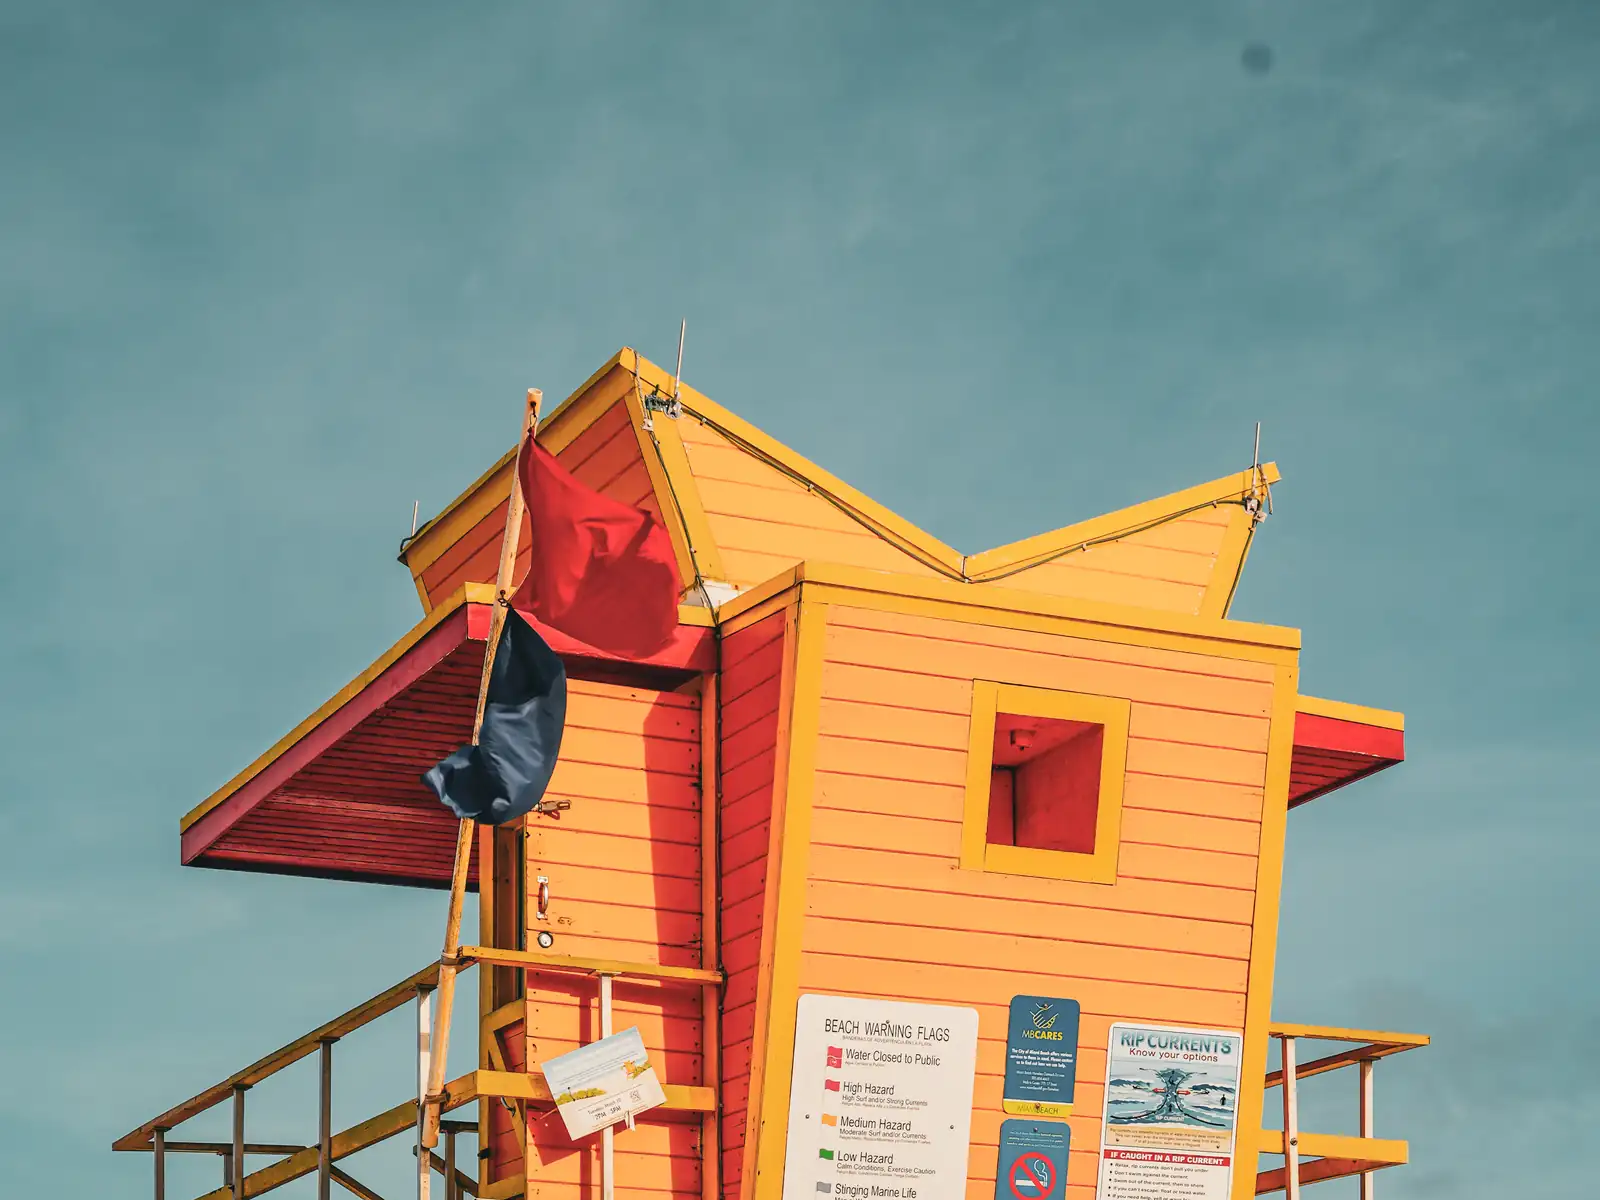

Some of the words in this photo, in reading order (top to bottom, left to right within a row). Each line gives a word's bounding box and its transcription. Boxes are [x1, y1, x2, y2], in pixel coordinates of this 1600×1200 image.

[825, 1018, 859, 1034] BEACH
[865, 1022, 912, 1038] WARNING
[918, 1026, 950, 1041] FLAGS
[1022, 1030, 1063, 1040] MBCARES
[1120, 1031, 1147, 1048] RIP
[1148, 1032, 1232, 1055] CURRENTS
[846, 1048, 871, 1061] Water
[873, 1050, 902, 1063] Closed
[905, 1054, 912, 1063] to
[915, 1054, 940, 1066] Public
[1129, 1048, 1155, 1058] Know
[1158, 1050, 1180, 1061] your
[1183, 1052, 1218, 1063] options
[843, 1081, 862, 1095] High
[865, 1084, 894, 1095] Hazard
[886, 1098, 904, 1106] Strong
[840, 1116, 876, 1129] Medium
[879, 1119, 911, 1131] Hazard
[840, 1128, 867, 1136] Moderate
[838, 1151, 856, 1162] Low
[860, 1152, 893, 1164] Hazard
[854, 1164, 885, 1172] Conditions,
[835, 1183, 869, 1198] Stinging
[871, 1186, 900, 1197] Marine
[902, 1188, 917, 1198] Life
